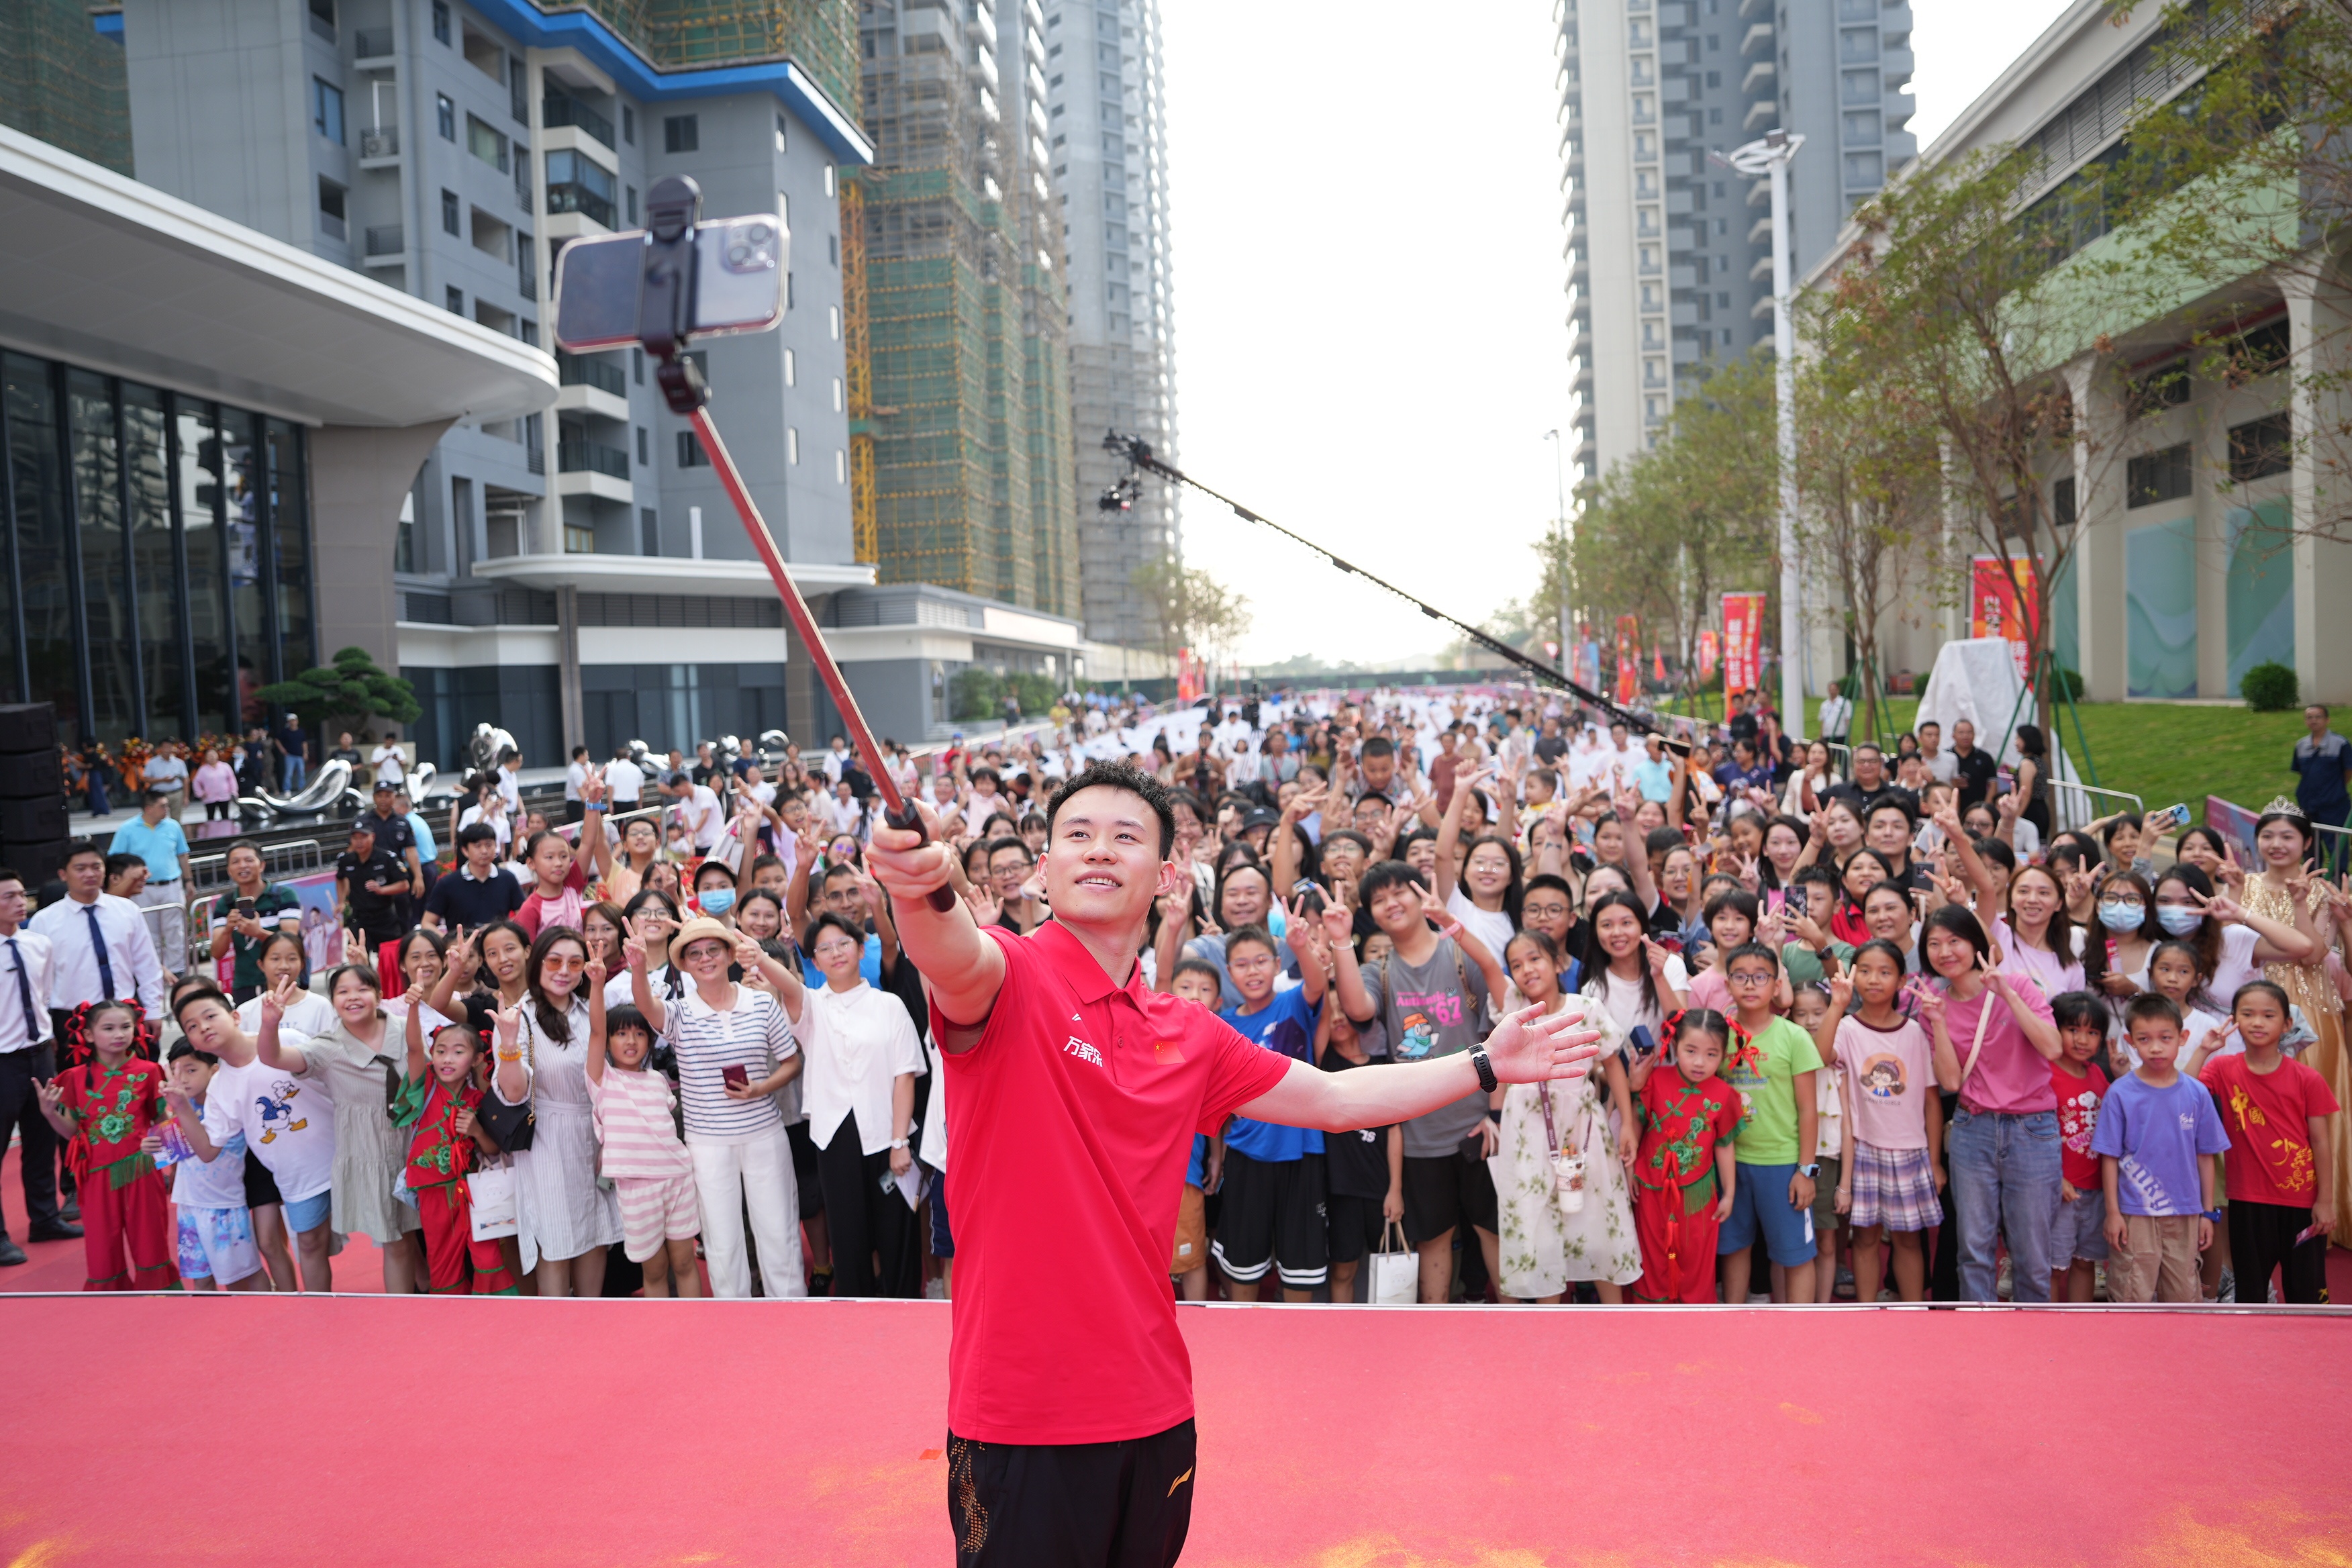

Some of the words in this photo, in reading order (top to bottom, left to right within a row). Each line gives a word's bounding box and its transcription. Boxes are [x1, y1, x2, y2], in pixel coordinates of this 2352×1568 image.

[1435, 995, 1463, 1024] 67
[1063, 1035, 1103, 1067] 万家乐
